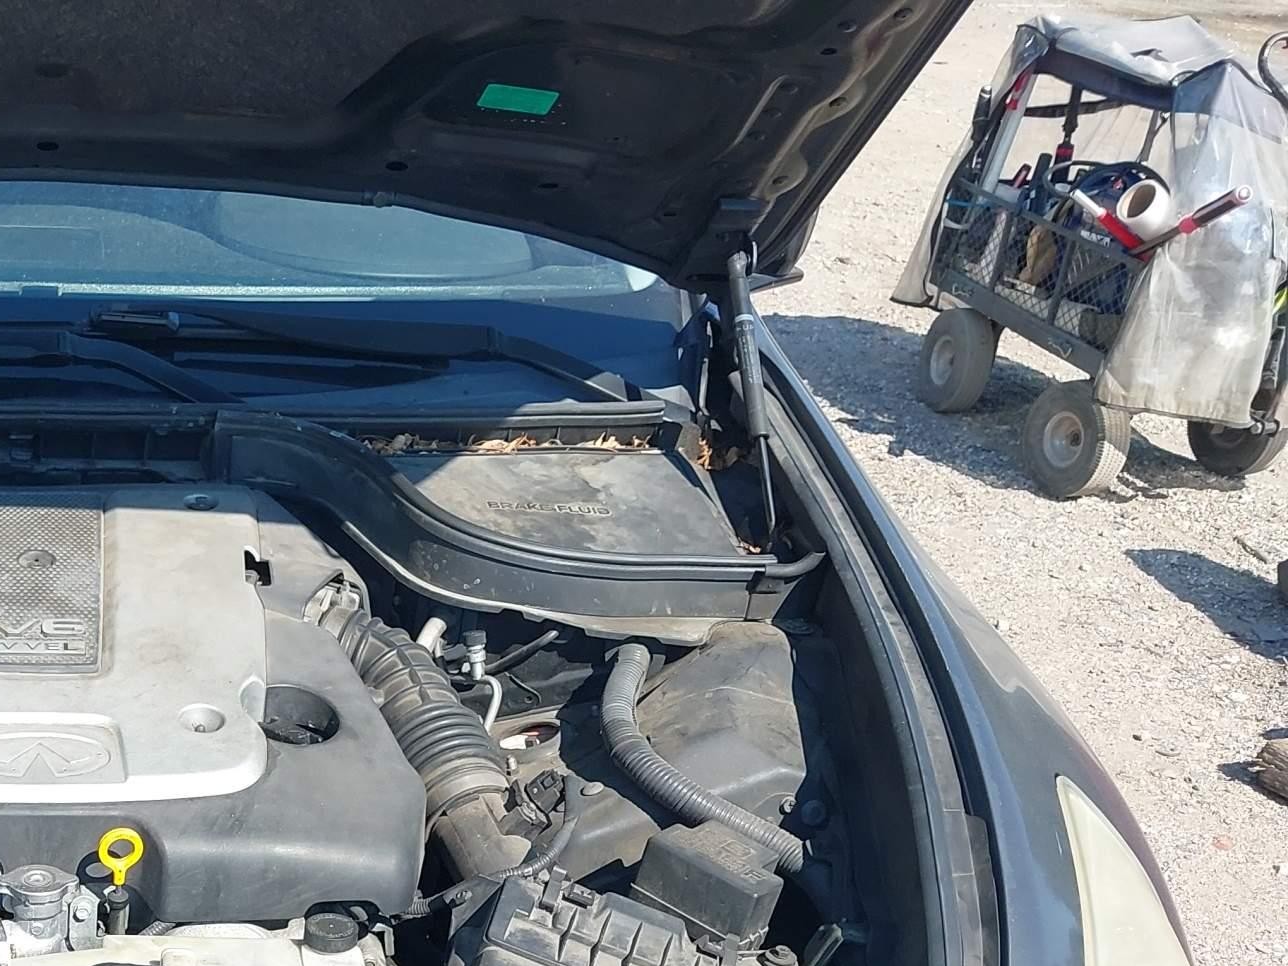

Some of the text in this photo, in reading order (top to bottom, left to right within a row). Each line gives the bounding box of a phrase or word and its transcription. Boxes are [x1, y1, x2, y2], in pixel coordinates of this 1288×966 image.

[487, 501, 611, 516] BRAKE FLUID
[0, 641, 85, 651] VVEL
